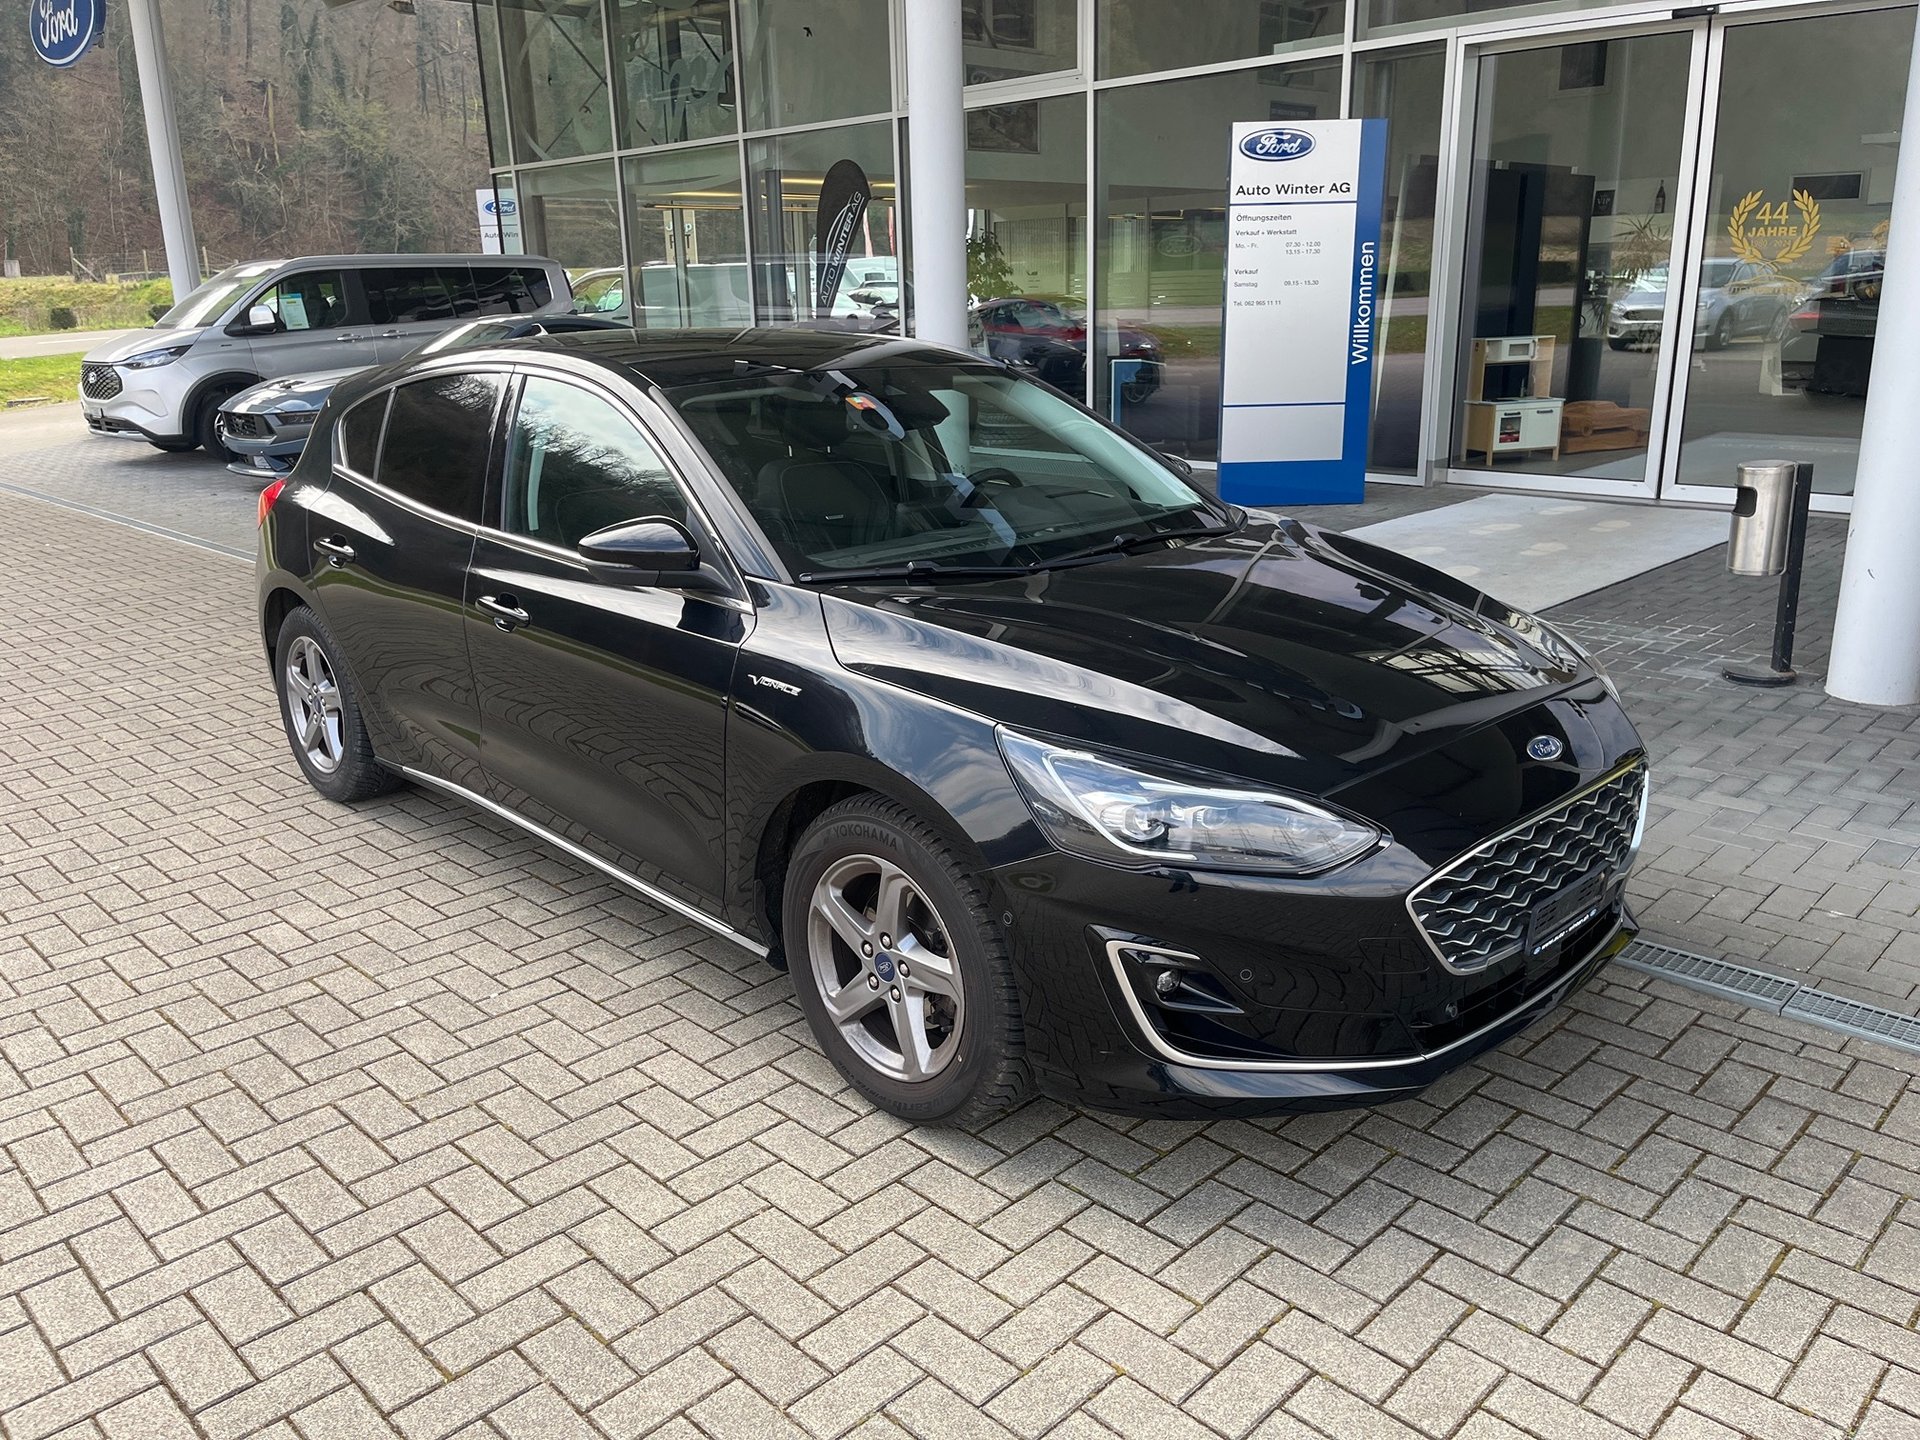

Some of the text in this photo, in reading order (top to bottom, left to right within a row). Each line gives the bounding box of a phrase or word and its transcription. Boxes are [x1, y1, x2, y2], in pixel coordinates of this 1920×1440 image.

[40, 0, 78, 48] Ford
[1256, 133, 1303, 154] Ford
[1236, 182, 1351, 196] Auto Winter AG
[1235, 213, 1293, 223] Öffnungszeiten
[1755, 201, 1789, 225] 44
[1747, 226, 1798, 237] JAHRE
[820, 191, 862, 305] AUTO WINTER AG
[1351, 241, 1375, 365] Willkommen
[747, 674, 802, 696] VIGNALE
[833, 823, 897, 851] YOKOHAMA
